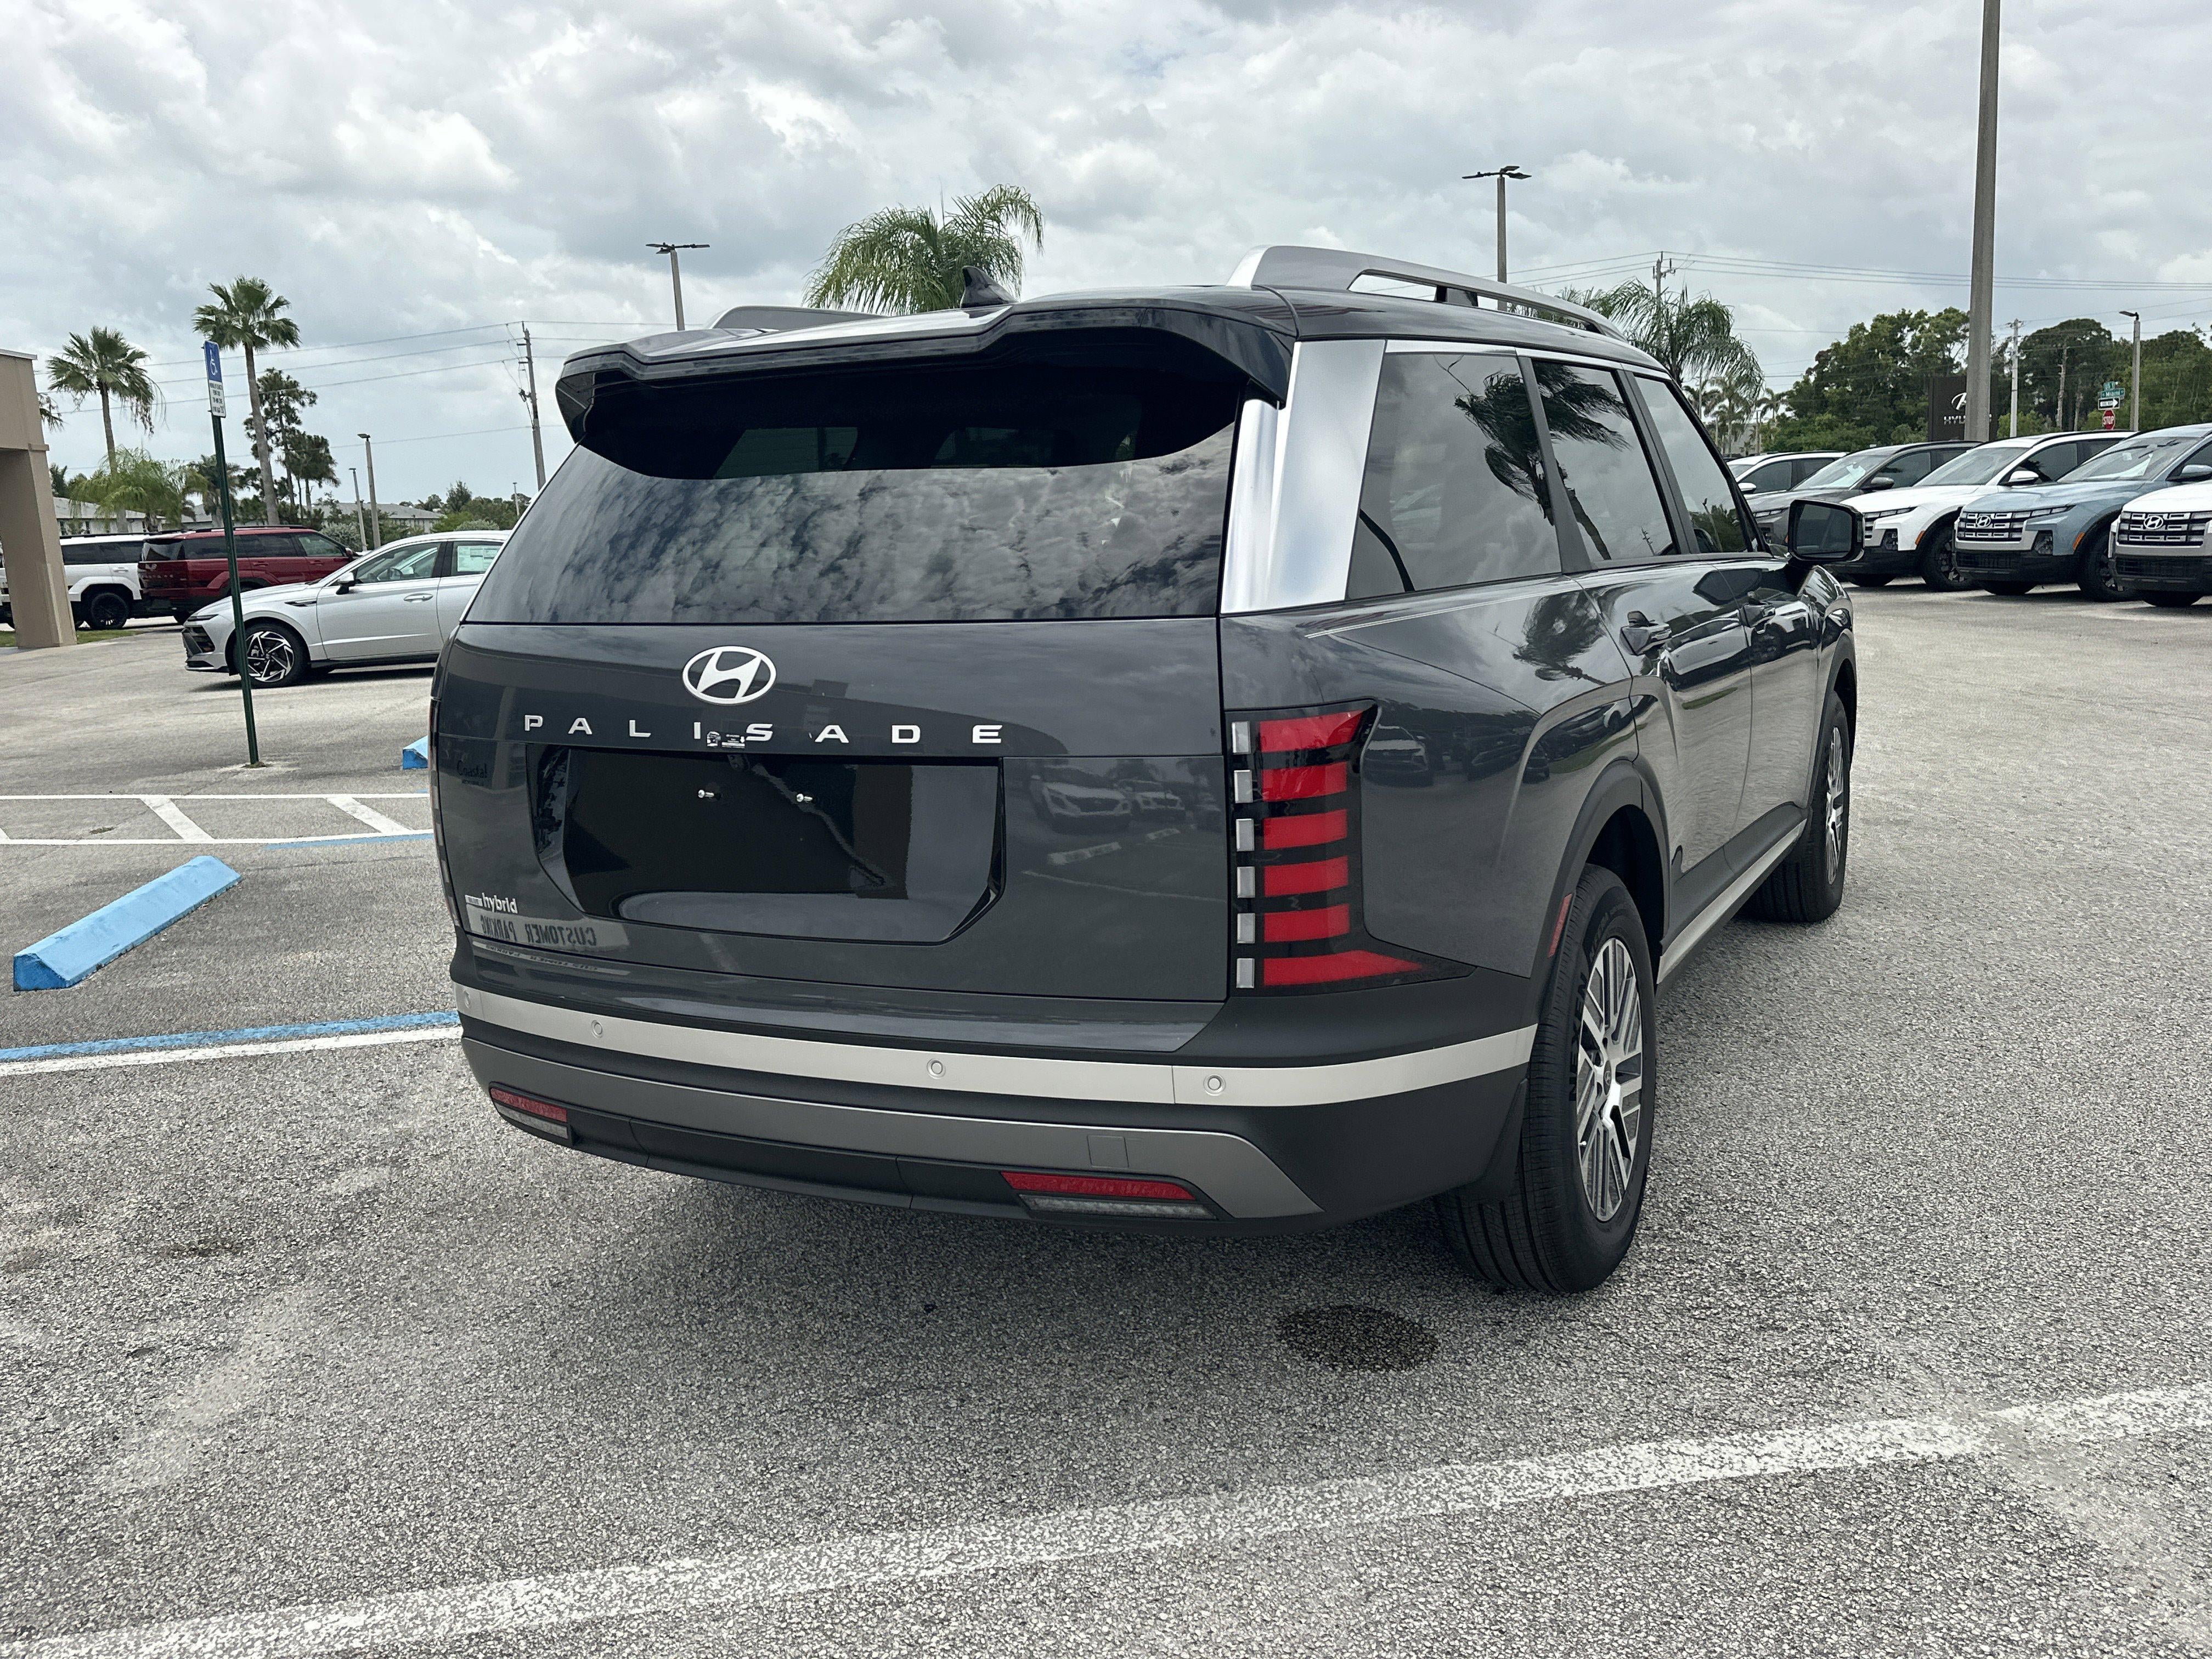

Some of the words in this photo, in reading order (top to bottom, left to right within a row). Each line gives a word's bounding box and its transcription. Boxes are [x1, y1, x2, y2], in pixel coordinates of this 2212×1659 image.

[2102, 416, 2114, 425] STOP
[524, 714, 1003, 744] PALISADE
[482, 892, 518, 914] hybrid
